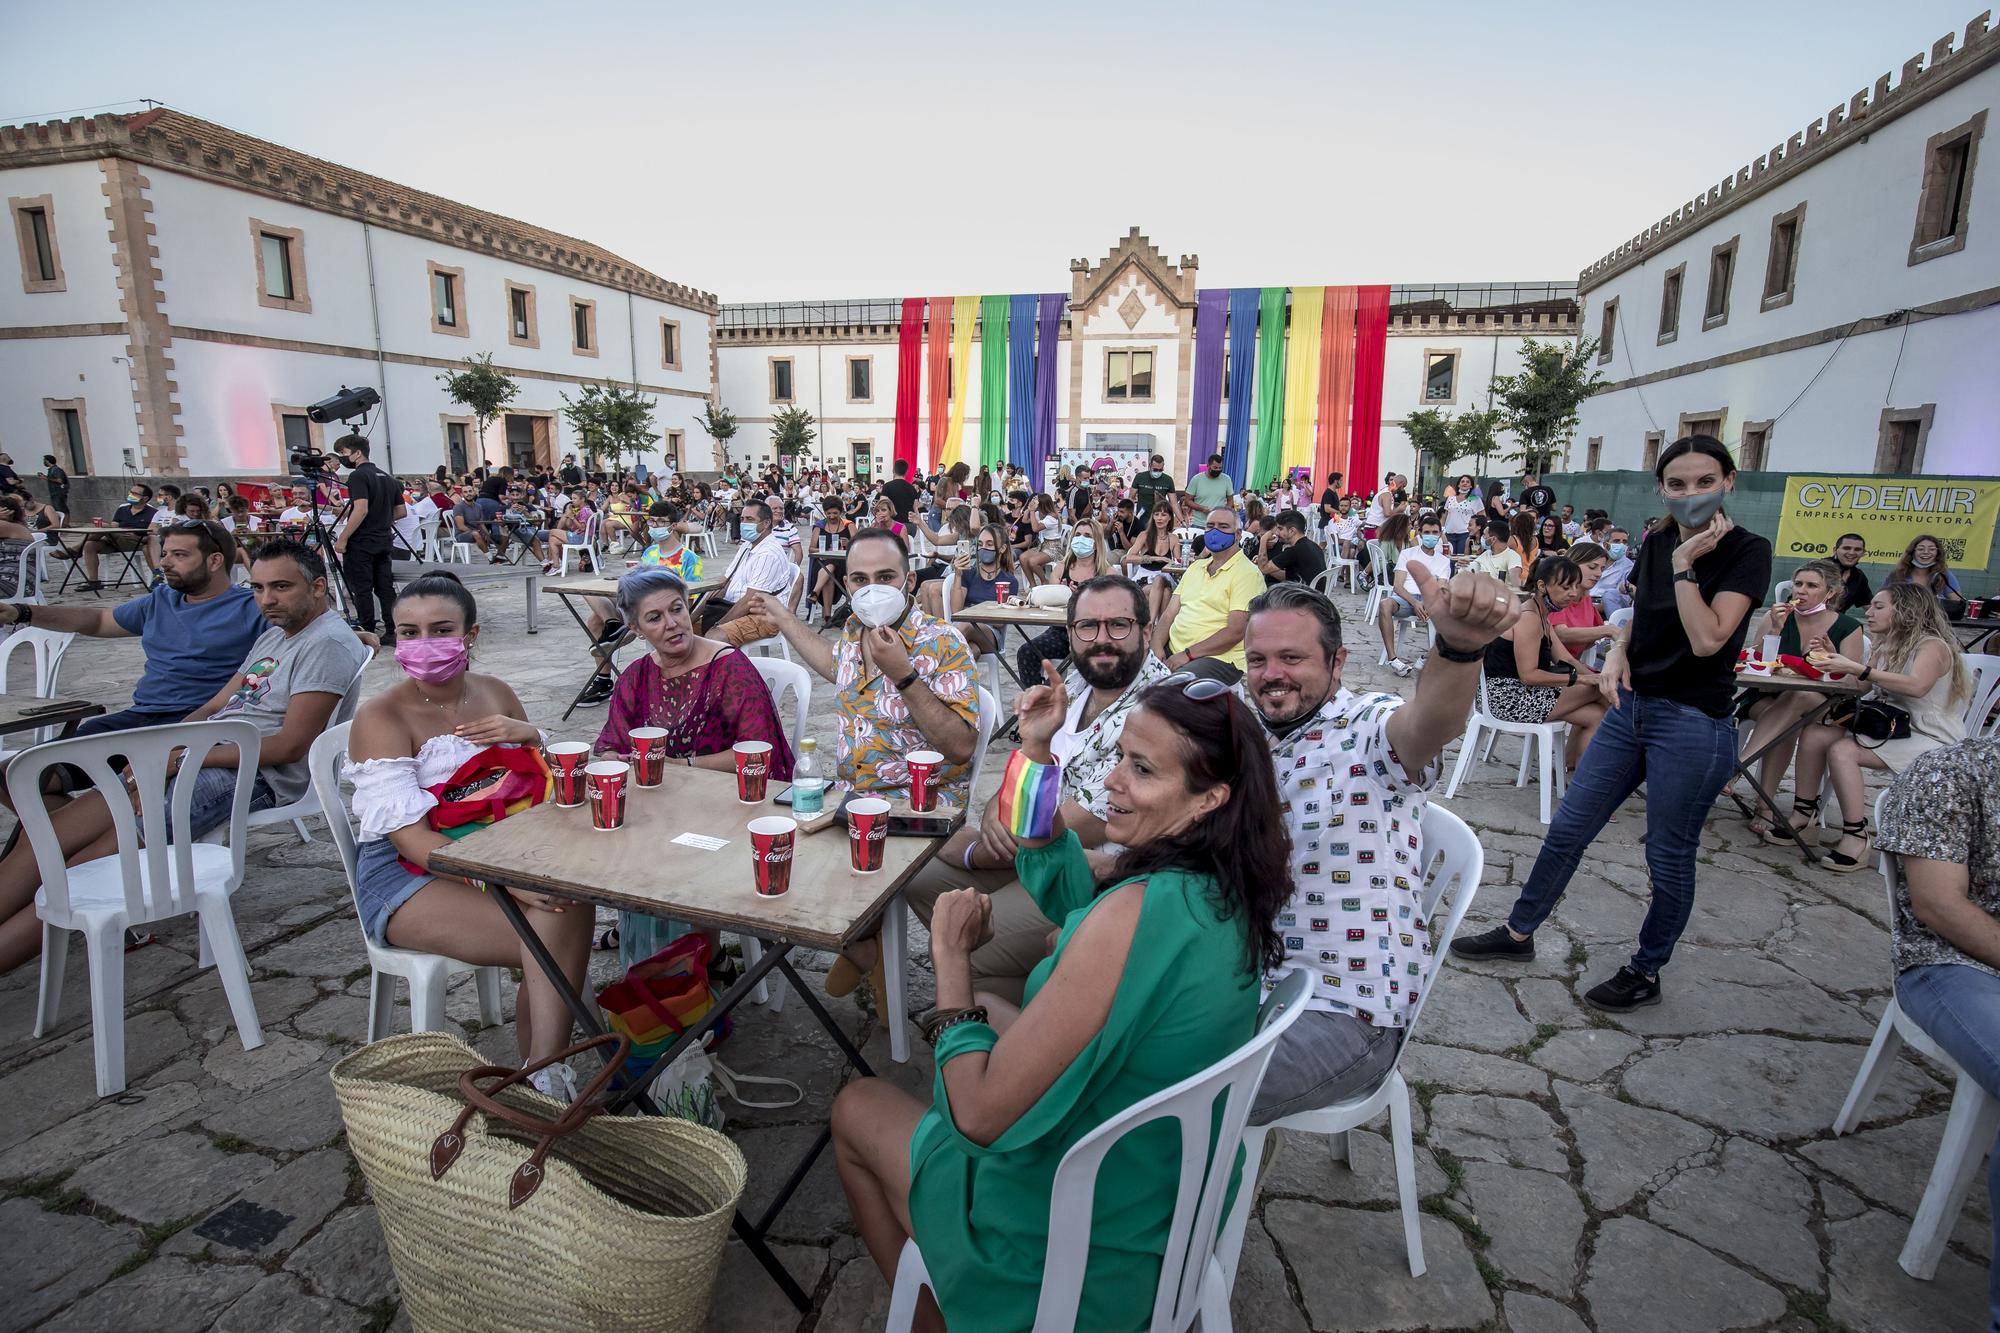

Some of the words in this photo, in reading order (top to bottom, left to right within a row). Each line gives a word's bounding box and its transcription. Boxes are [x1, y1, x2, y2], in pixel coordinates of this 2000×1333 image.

[1799, 482, 1977, 514] CYDEMIR
[1795, 510, 1854, 520] EMPRESA
[1861, 513, 1973, 526] CONSTRUCTORA
